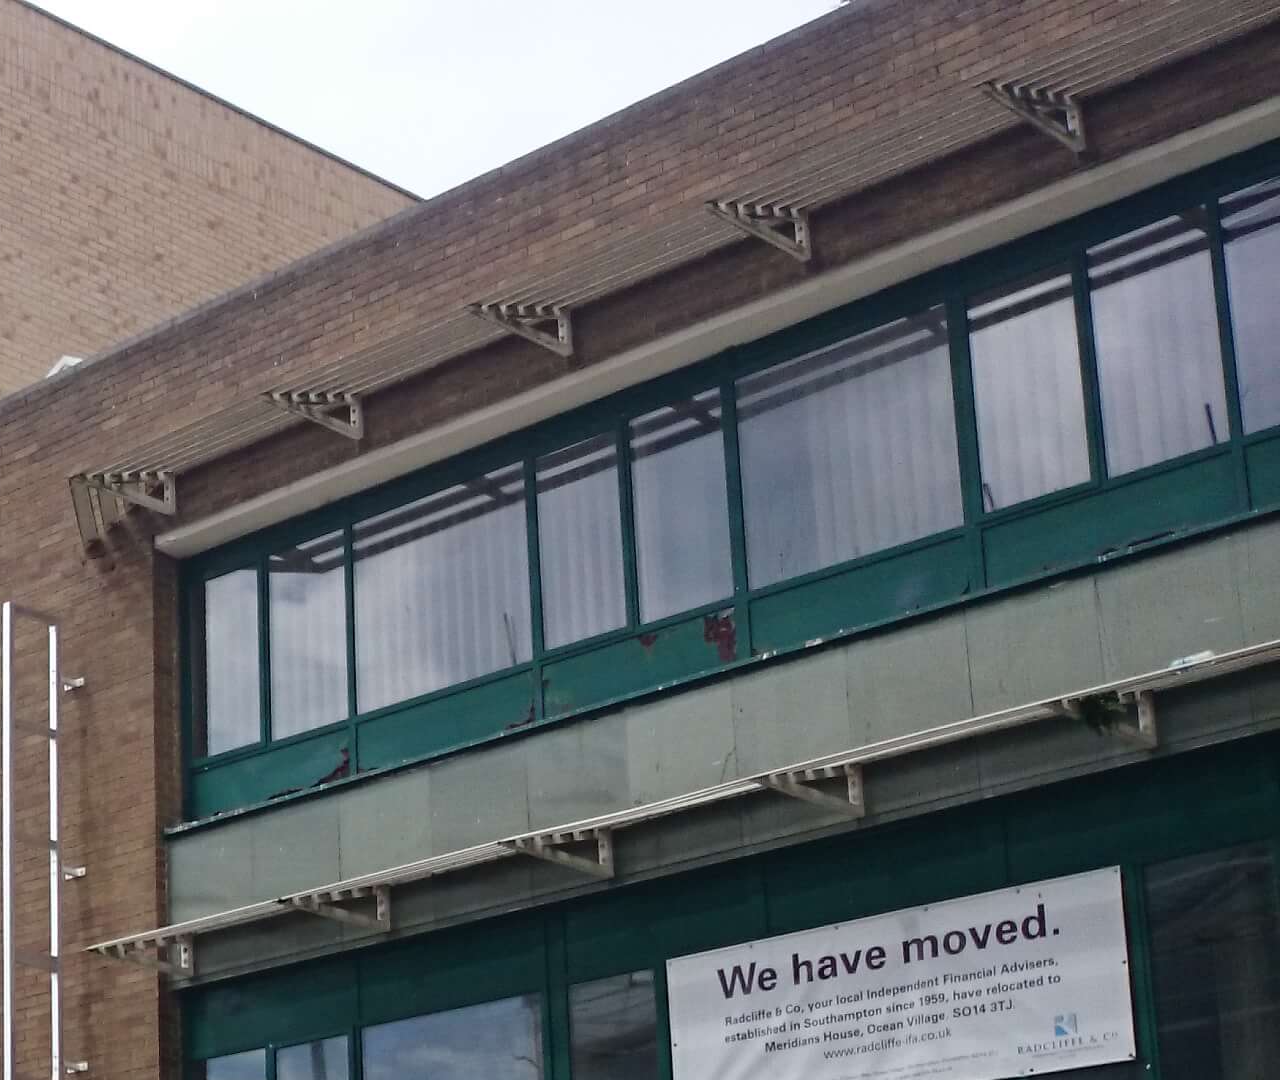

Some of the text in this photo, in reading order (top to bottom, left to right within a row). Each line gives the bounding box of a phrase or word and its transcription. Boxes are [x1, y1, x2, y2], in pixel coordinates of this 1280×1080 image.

[717, 903, 1060, 999] We have moved.
[725, 957, 1059, 1026] Radcliffe & Co, your local Independent Financial Advisers,
[725, 974, 1061, 1043] established in Southampton since 1959, have relocated to
[765, 1034, 820, 1053] Meridians
[823, 1027, 865, 1042] House,
[866, 1018, 904, 1034] Ocean
[952, 1002, 986, 1018] SO14
[823, 1027, 952, 1059] www.radcliffe-ifa.co.uk
